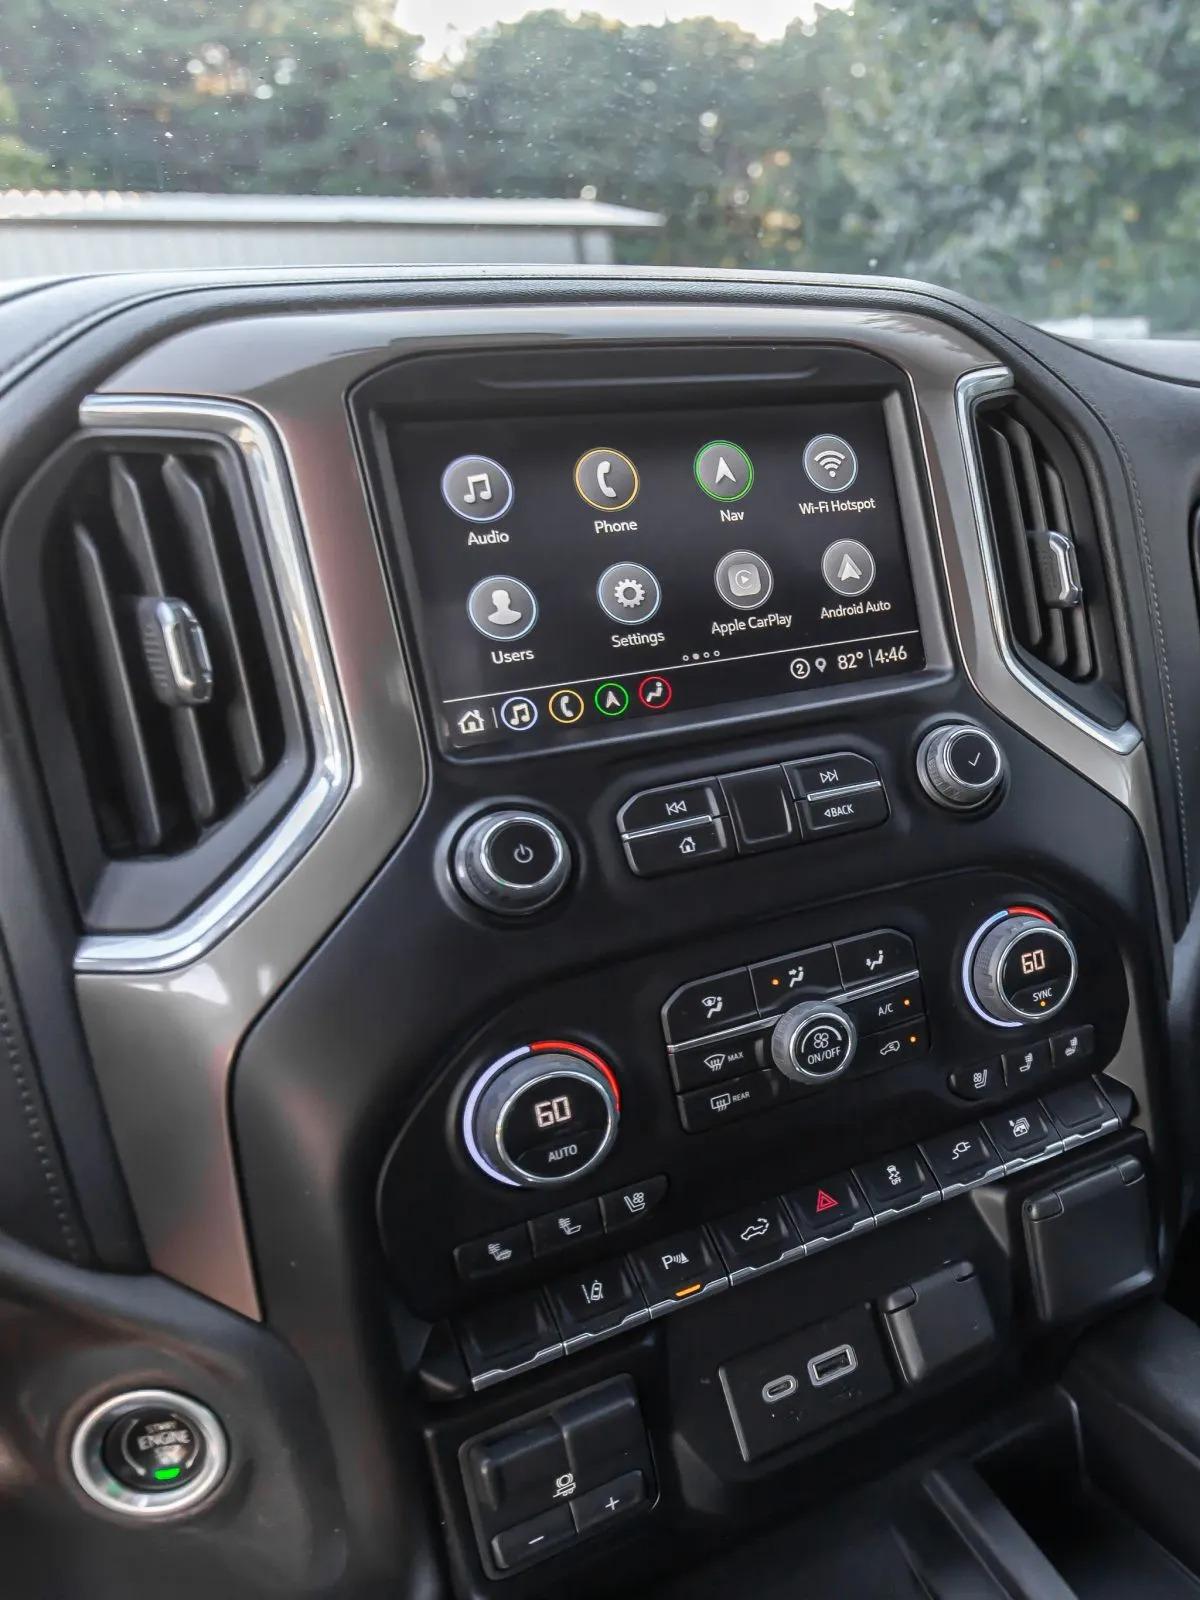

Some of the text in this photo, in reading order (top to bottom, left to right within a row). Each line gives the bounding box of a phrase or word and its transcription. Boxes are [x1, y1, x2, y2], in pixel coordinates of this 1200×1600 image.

[799, 498, 875, 514] Wi-Fi Hotspot
[720, 510, 744, 521] Nav
[594, 520, 637, 533] Phone
[468, 530, 509, 545] Audio
[820, 601, 890, 619] Android Auto
[711, 613, 792, 636] Apple CarPlay
[612, 633, 664, 647] Settings
[491, 651, 534, 664] Users
[838, 652, 863, 669] 82°
[876, 646, 907, 663] 4:46
[830, 804, 854, 817] BACK
[1022, 950, 1045, 974] 60
[1033, 988, 1053, 1002] SYNC
[879, 1003, 893, 1016] A/C
[728, 1052, 743, 1061] MAX
[808, 1047, 841, 1065] ON/OFF
[733, 1092, 750, 1101] REAR
[535, 1097, 571, 1127] 60
[549, 1145, 577, 1161] AUTO
